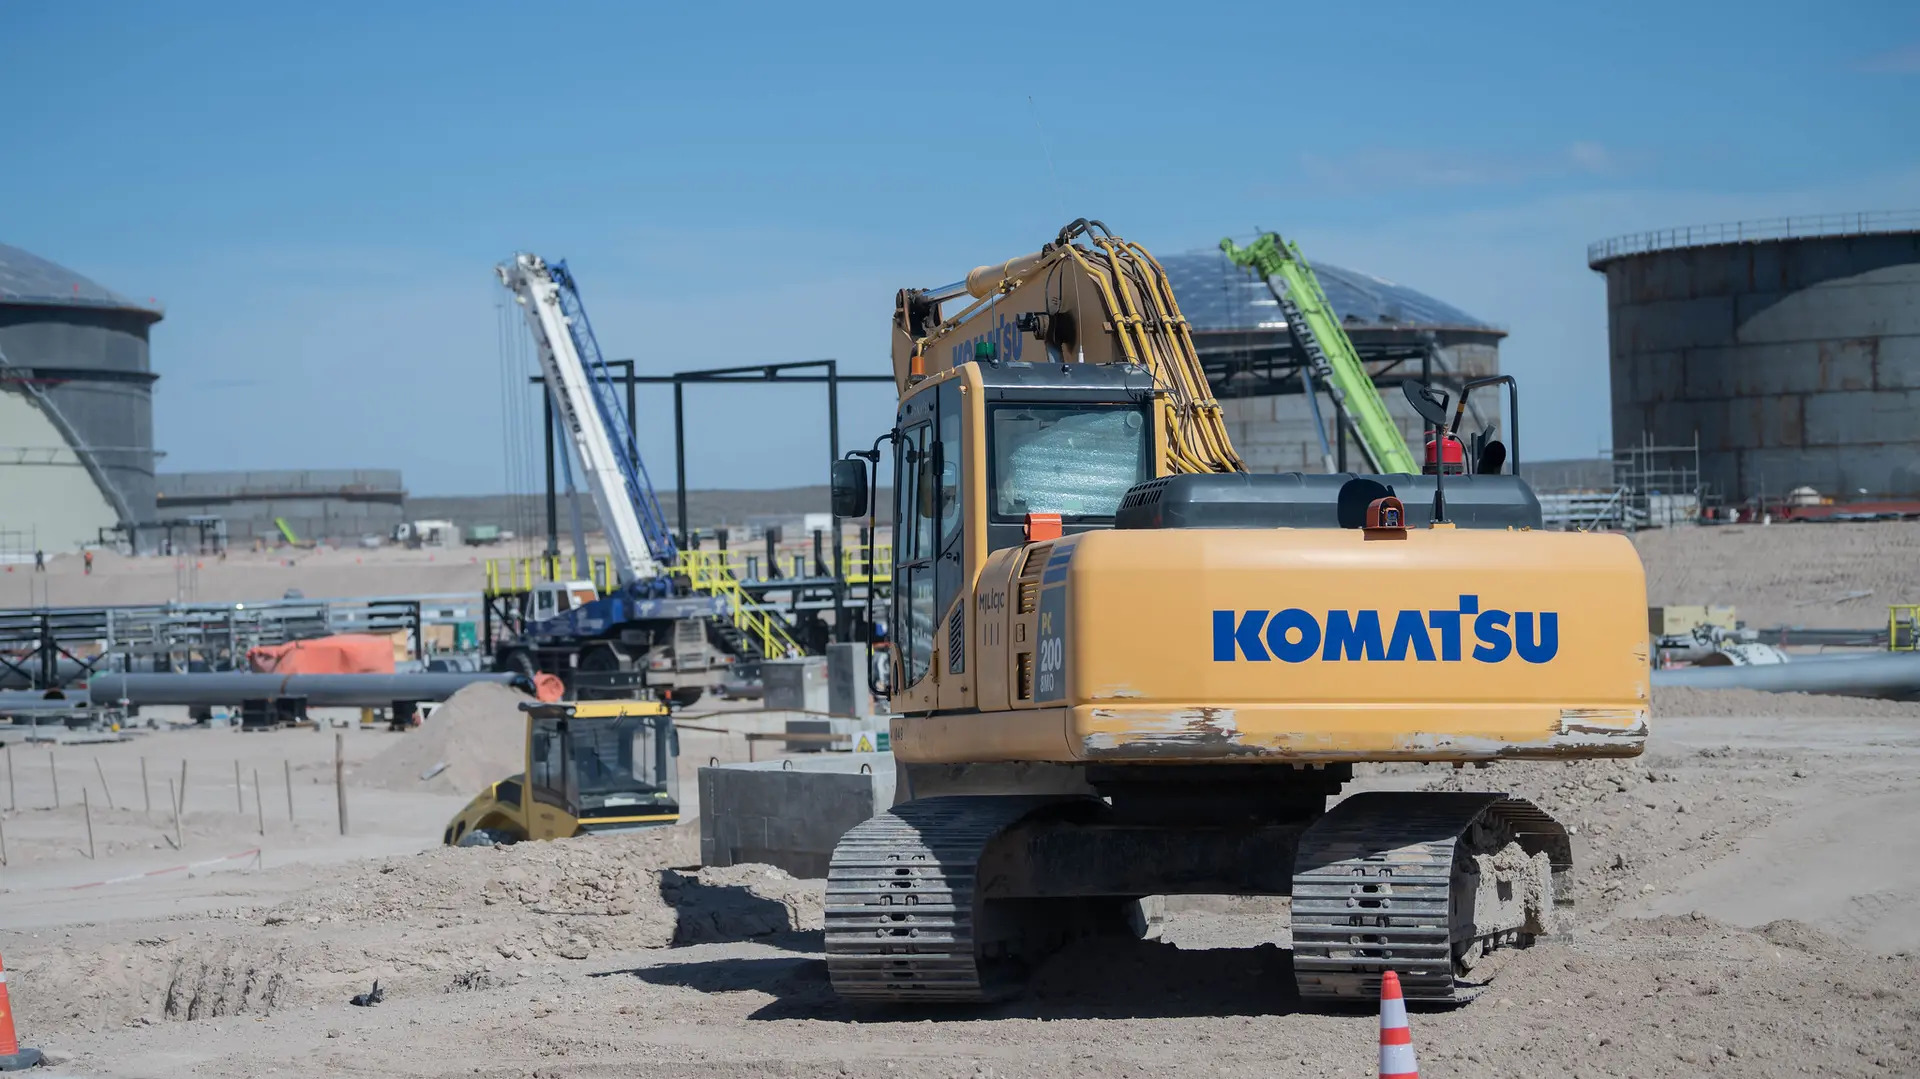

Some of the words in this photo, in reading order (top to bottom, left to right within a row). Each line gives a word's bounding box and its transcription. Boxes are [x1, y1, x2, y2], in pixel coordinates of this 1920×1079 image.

[952, 313, 1023, 367] KOTSU
[1041, 612, 1052, 636] PC
[1212, 594, 1559, 664] KOMATSU
[1040, 637, 1062, 672] 200
